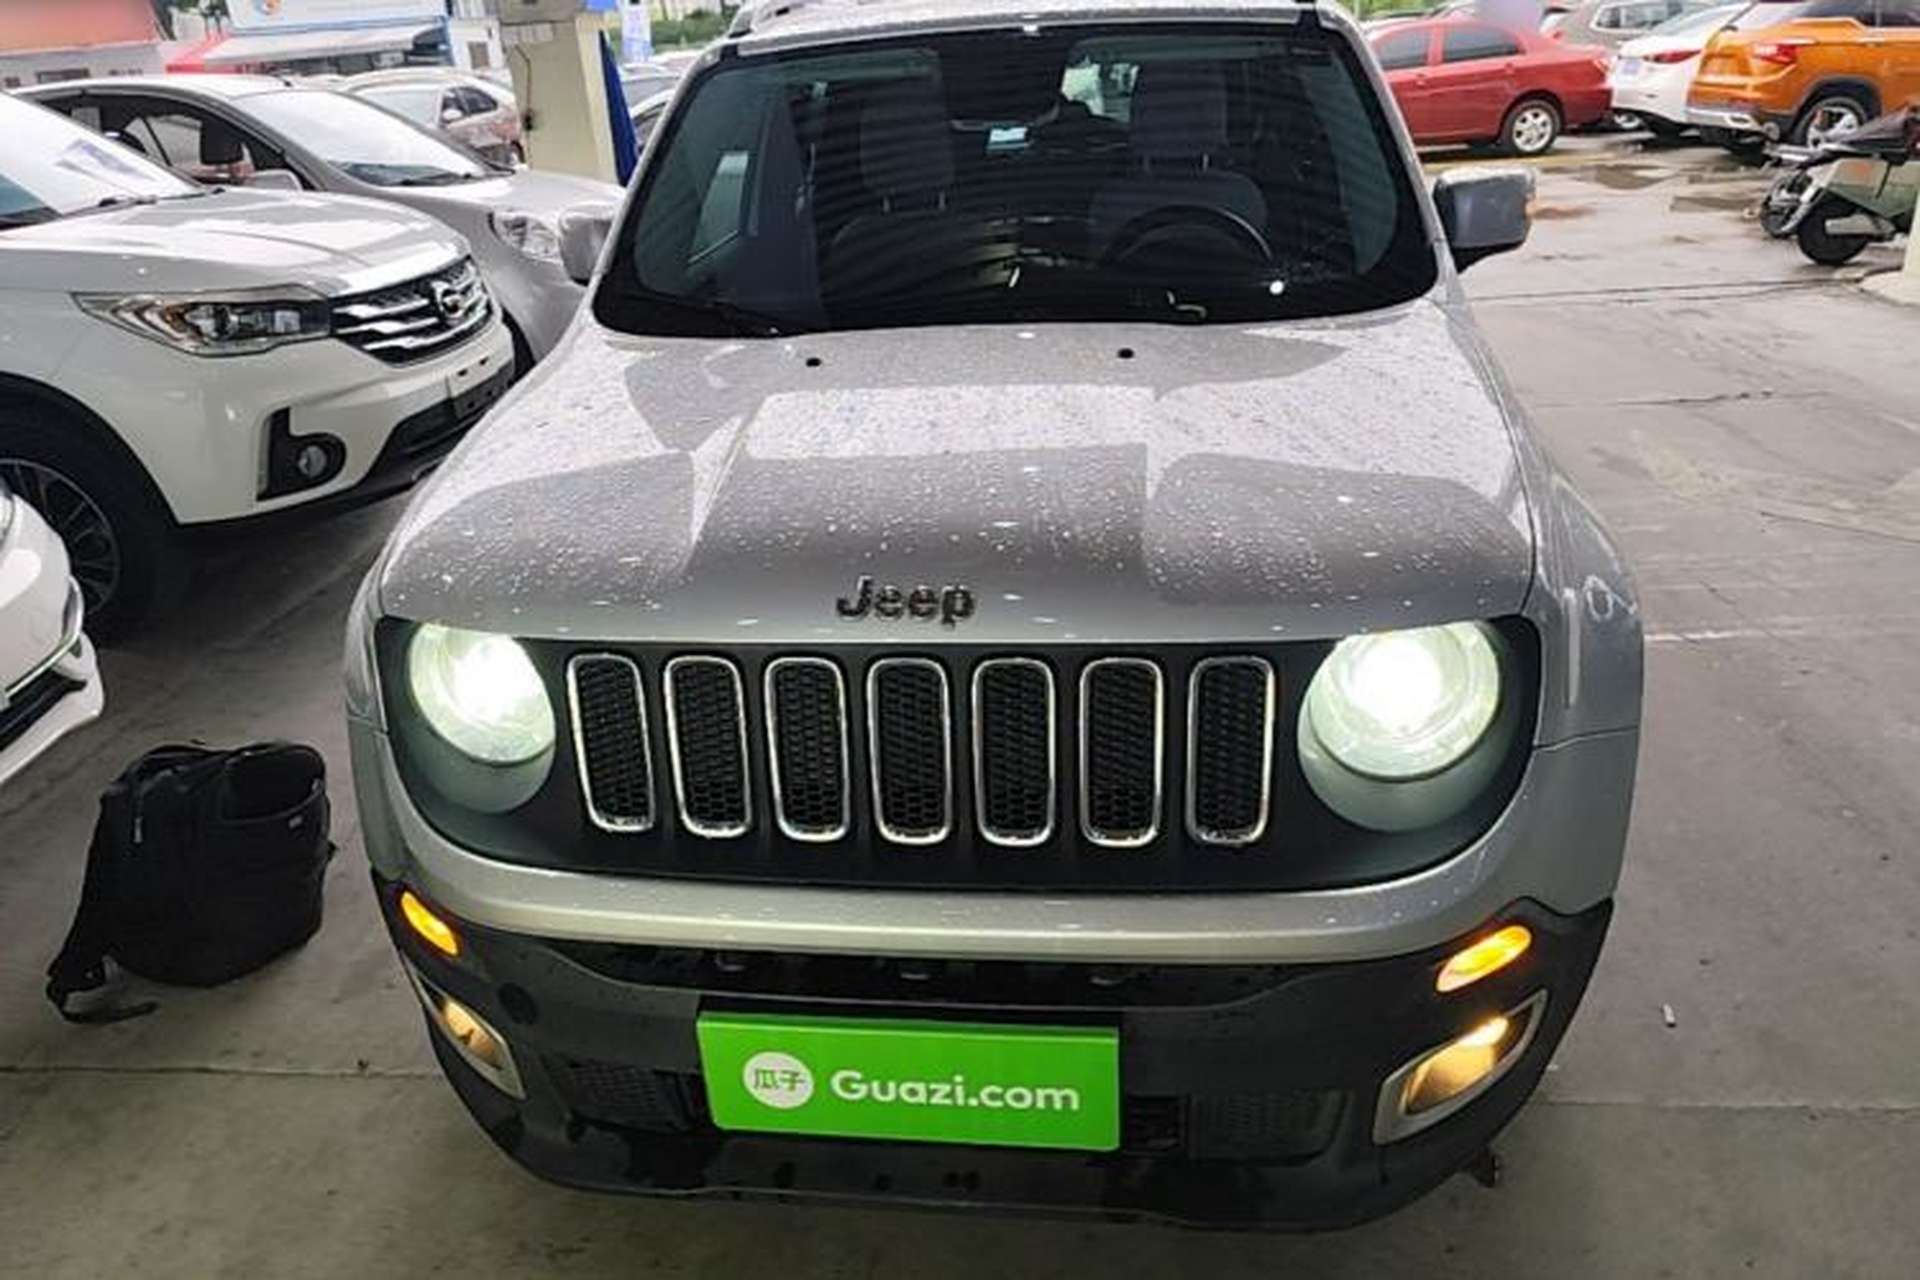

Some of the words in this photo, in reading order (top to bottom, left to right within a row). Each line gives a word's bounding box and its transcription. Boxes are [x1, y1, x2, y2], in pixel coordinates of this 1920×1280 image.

[836, 574, 975, 627] Jeep
[753, 1068, 806, 1092] 瓜子
[830, 1069, 1080, 1111] Guazi.com
